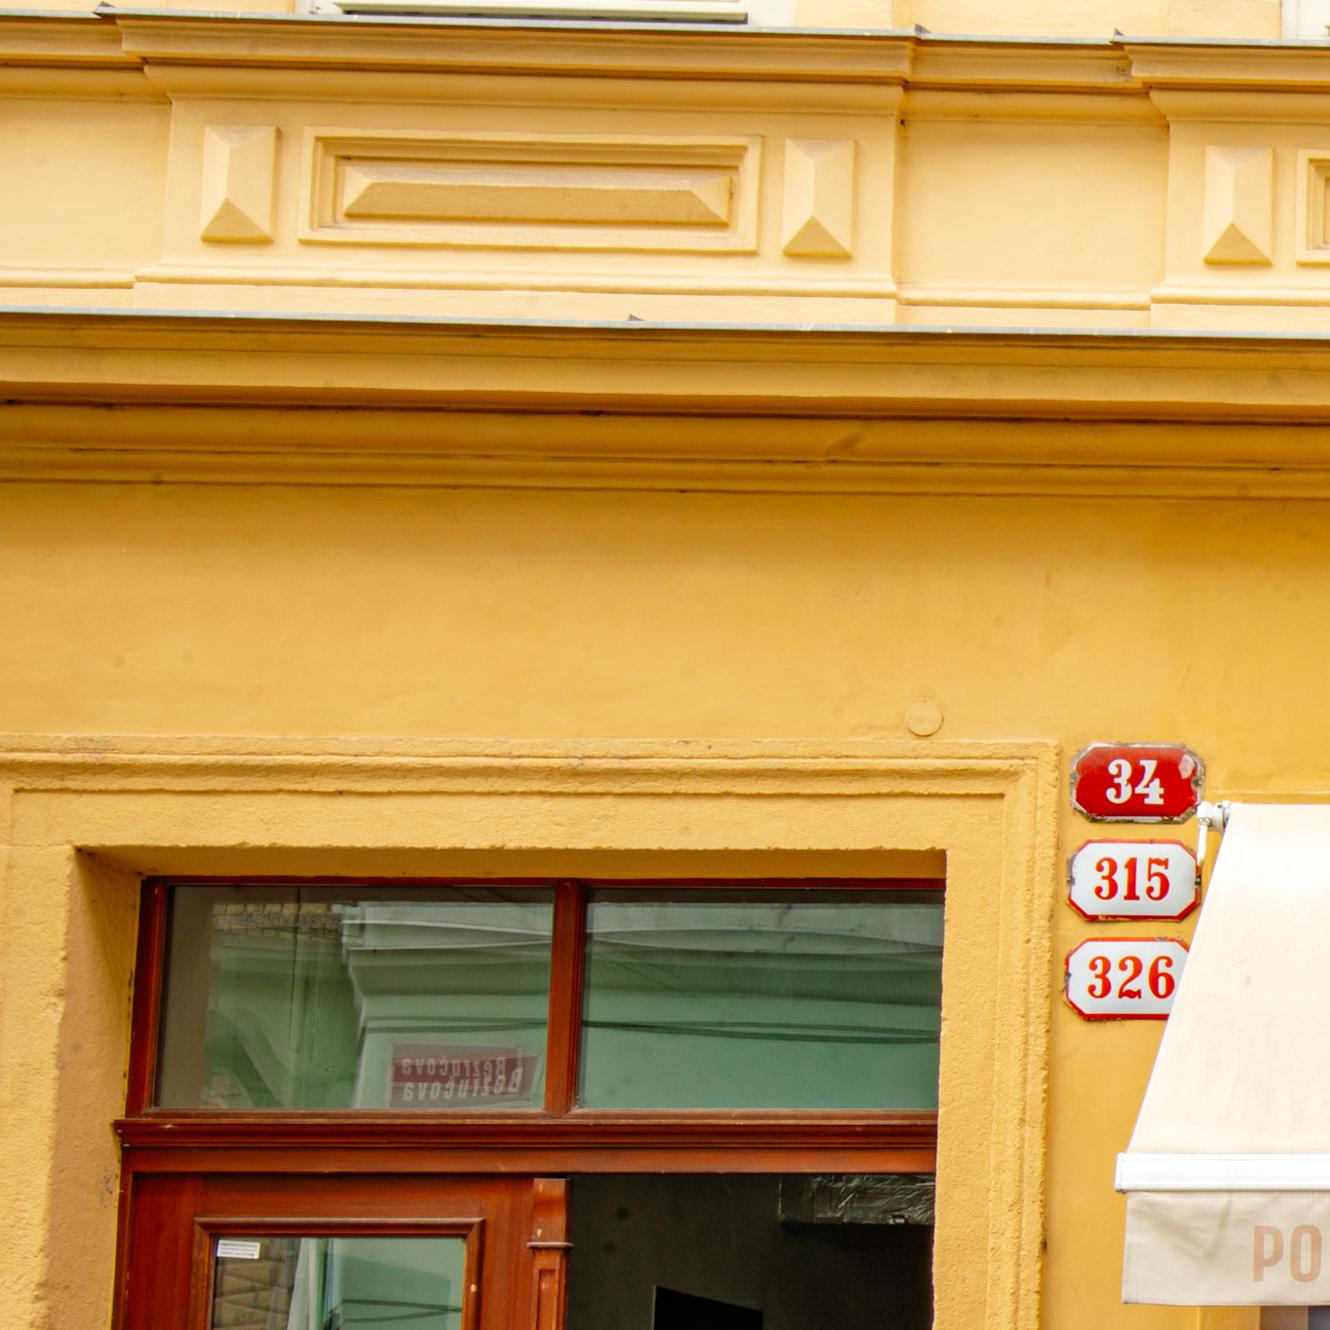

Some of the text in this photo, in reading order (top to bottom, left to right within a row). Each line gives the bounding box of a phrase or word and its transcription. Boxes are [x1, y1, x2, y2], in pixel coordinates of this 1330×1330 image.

[1105, 758, 1165, 805] 34
[1094, 856, 1170, 901] 315
[1087, 955, 1175, 1000] 326
